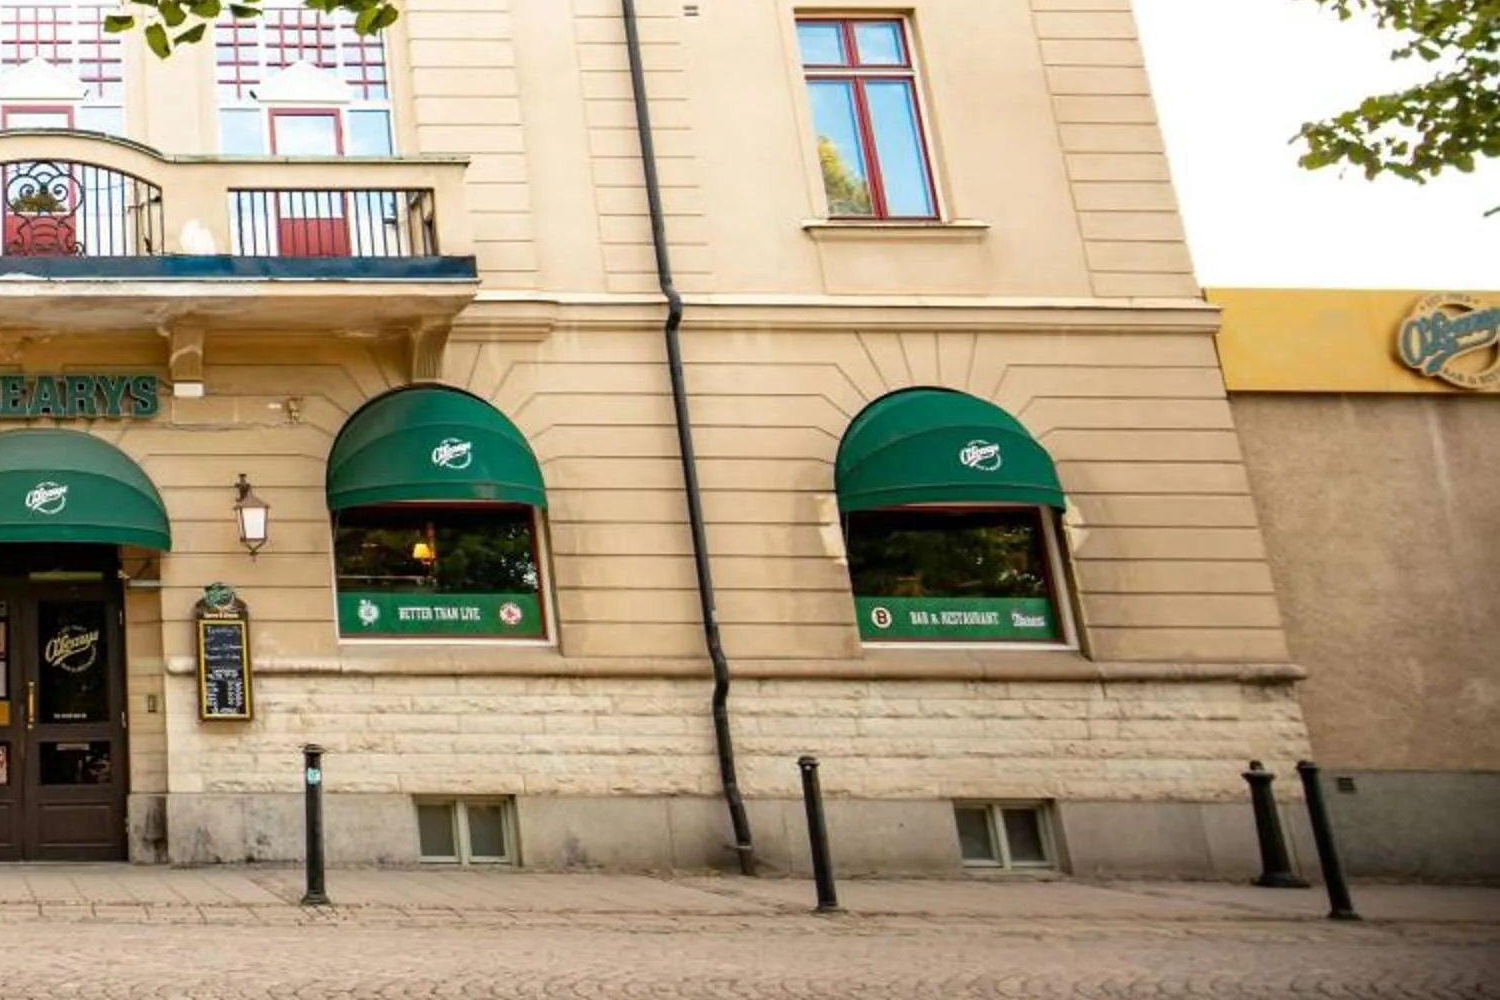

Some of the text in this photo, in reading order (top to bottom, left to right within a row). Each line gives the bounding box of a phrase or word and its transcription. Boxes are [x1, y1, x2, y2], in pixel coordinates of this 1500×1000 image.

[399, 606, 481, 621] BETTER THAN LIVE
[909, 611, 929, 625] BAR
[941, 611, 1000, 626] RESTAURANT
